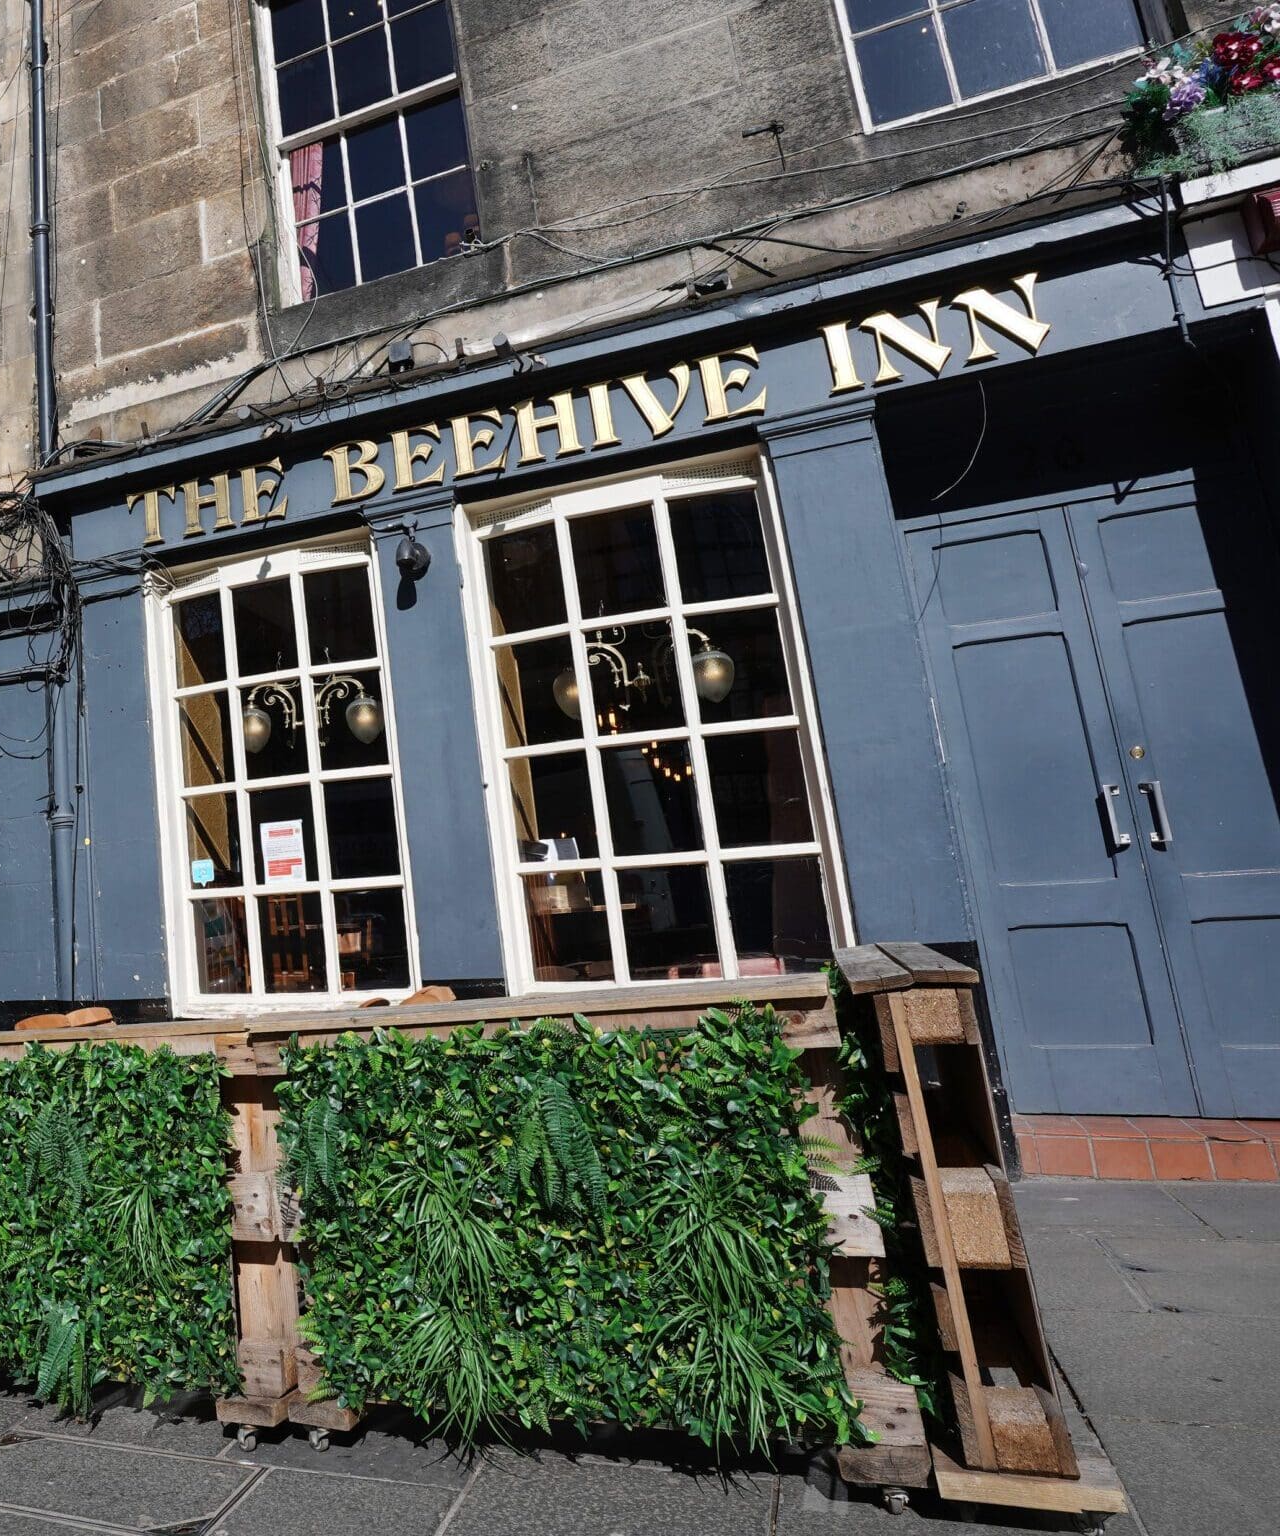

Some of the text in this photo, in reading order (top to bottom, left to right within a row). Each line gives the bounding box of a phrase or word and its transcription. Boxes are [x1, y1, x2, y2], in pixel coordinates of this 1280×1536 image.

[126, 271, 1052, 546] THE BEEHIVE INN
